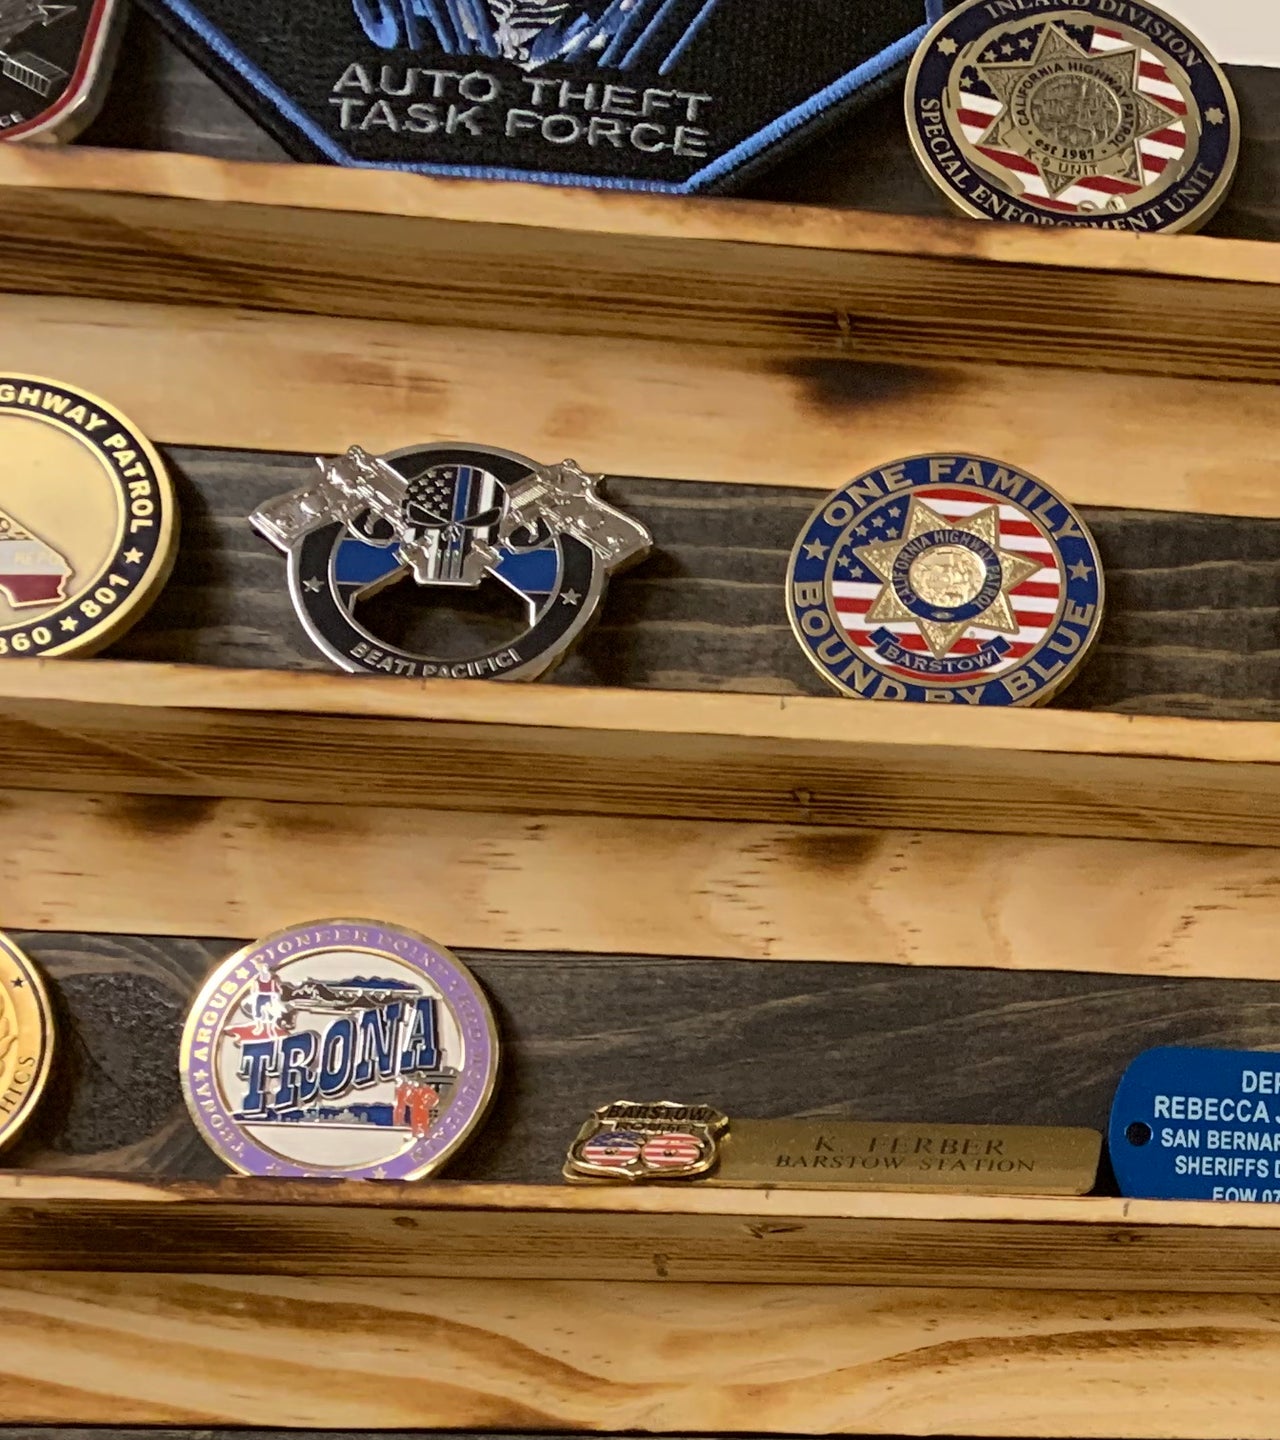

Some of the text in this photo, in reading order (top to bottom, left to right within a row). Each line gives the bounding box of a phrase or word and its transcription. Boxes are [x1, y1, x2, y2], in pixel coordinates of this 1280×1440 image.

[333, 63, 712, 122] AUTO THEFT
[329, 98, 710, 157] TASK FORCE
[823, 458, 1084, 541] ONE FAMILY
[80, 573, 129, 618] 801
[886, 645, 992, 673] BARSTOW
[238, 995, 441, 1120] TRONA
[607, 1104, 717, 1122] BARSTOW
[1154, 1095, 1270, 1124] REBECCA
[1161, 1127, 1200, 1149] SAN
[775, 1154, 1036, 1174] BARSTOW STATION
[1174, 1155, 1269, 1178] SHERIFFS
